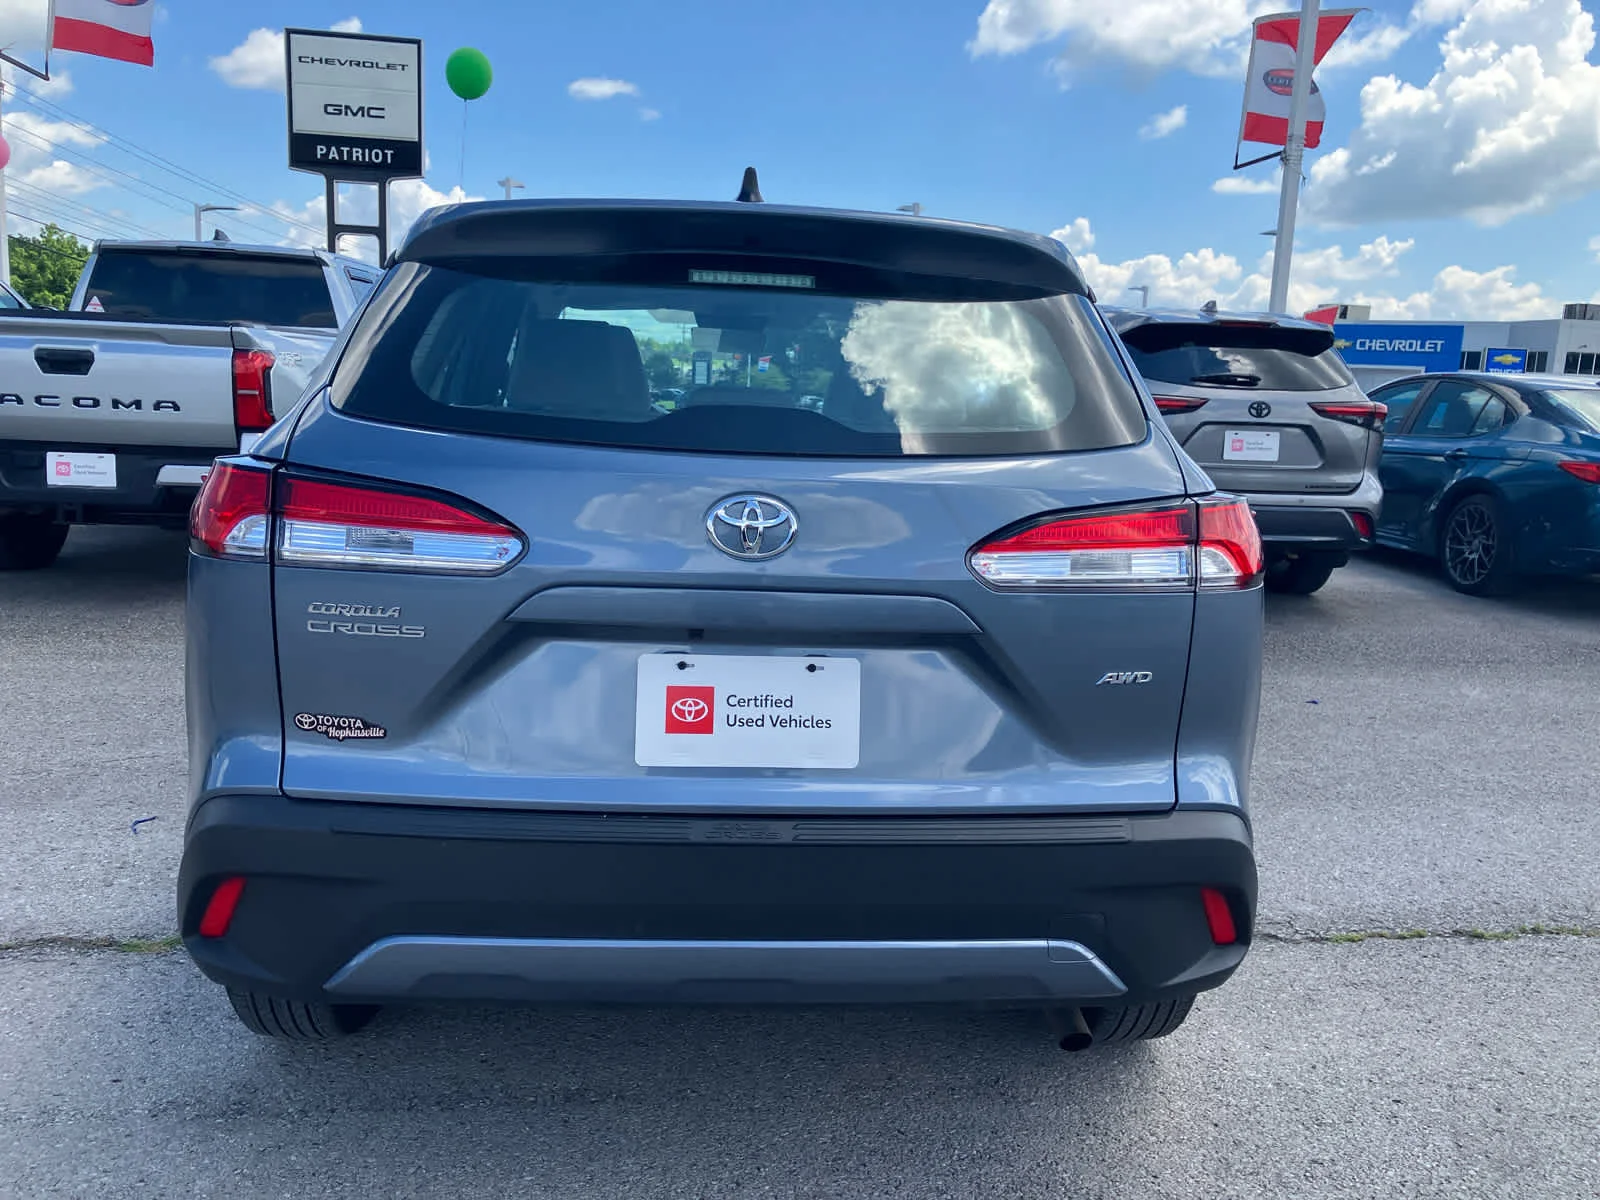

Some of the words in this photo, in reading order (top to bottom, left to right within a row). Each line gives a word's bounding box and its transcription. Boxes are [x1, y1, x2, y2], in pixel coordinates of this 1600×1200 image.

[297, 55, 408, 71] CHEVROLET
[323, 103, 385, 119] GMC
[316, 145, 395, 164] PATRIOT
[1356, 338, 1445, 353] CHEVROLET
[307, 602, 401, 618] COROLLA
[306, 620, 425, 638] CROSS
[1095, 671, 1153, 685] AWD
[726, 694, 793, 708] Certified
[316, 715, 364, 729] TOYOTA
[726, 714, 765, 728] Used
[769, 714, 832, 729] Vehicles
[316, 725, 328, 733] OF
[327, 726, 386, 740] Hopkinsville
